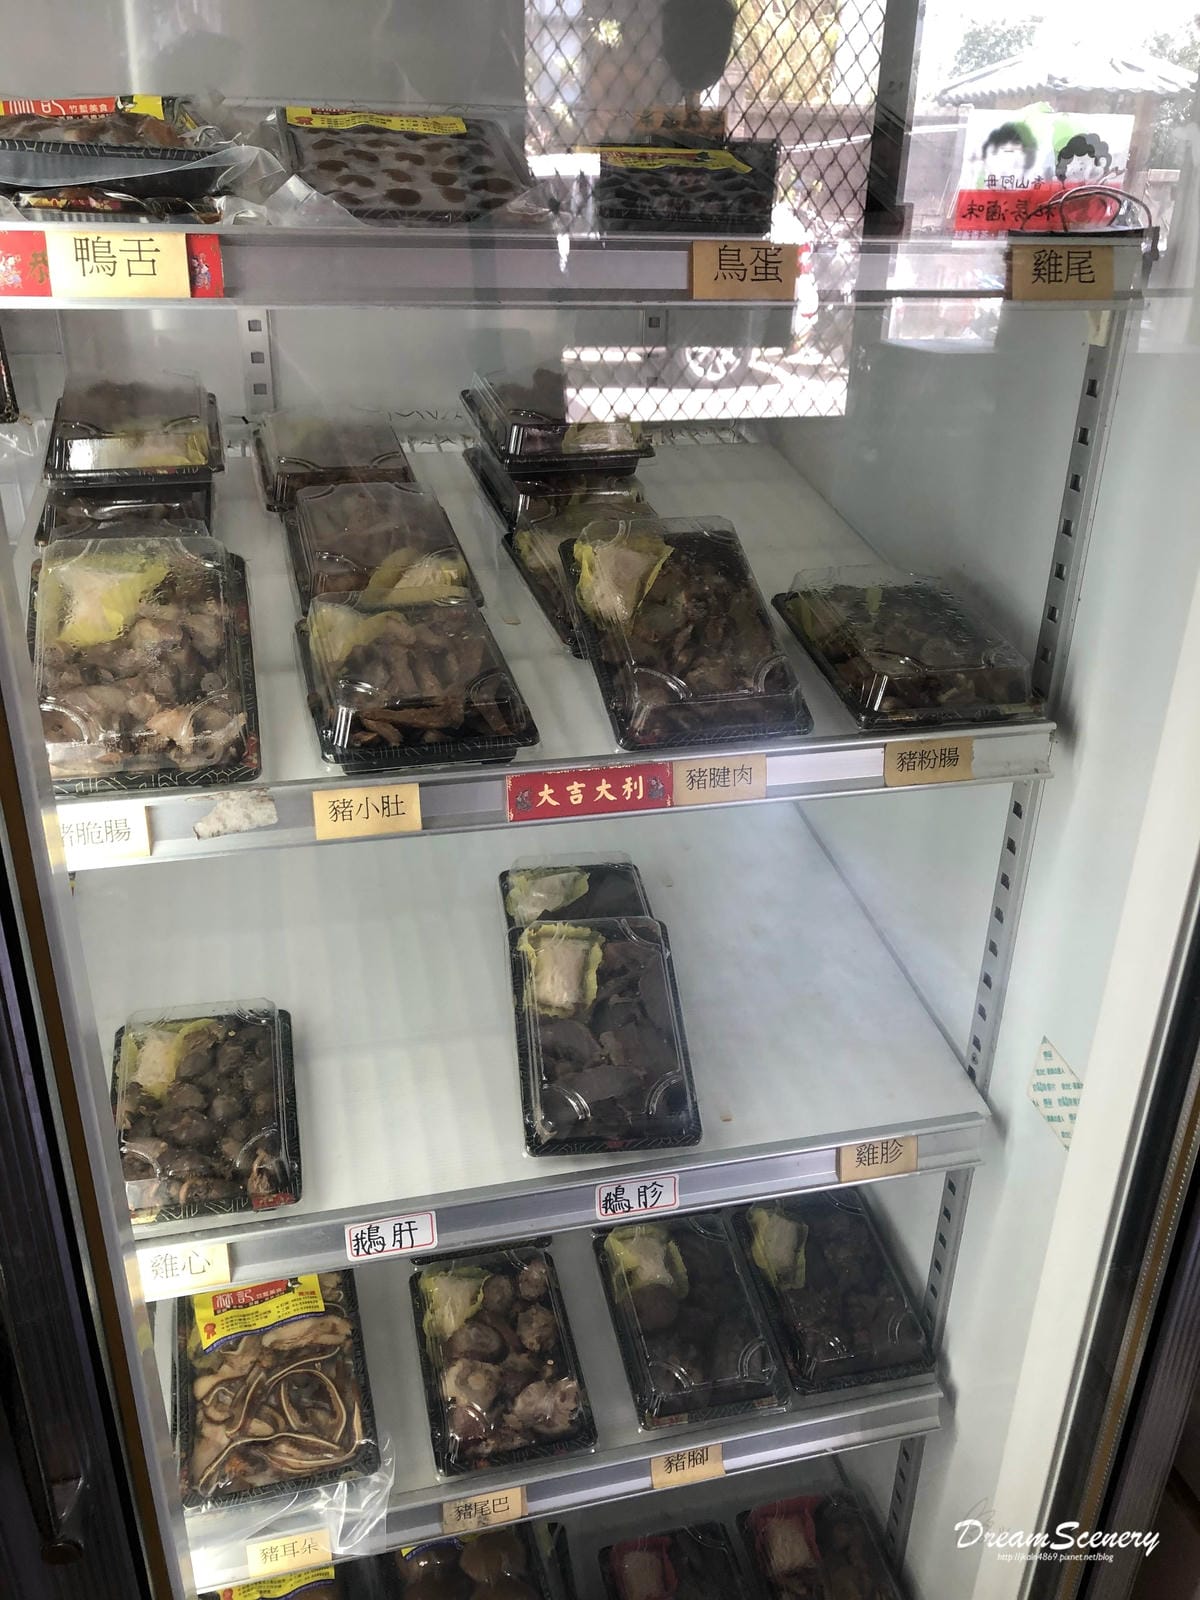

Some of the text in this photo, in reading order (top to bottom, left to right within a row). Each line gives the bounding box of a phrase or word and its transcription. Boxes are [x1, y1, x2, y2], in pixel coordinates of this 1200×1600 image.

[73, 236, 161, 278] 鴨舌
[713, 244, 783, 282] 鳥蛋
[1031, 249, 1096, 285] 雞尾
[896, 746, 961, 773] 豬粉腸
[535, 775, 645, 808] 大吉大利
[686, 764, 753, 791] 豬腱肉
[327, 793, 406, 823] 豬小肚
[855, 1138, 904, 1168] 雞胗
[602, 1181, 664, 1214] 鵝胗
[352, 1221, 418, 1257] 鵝肝
[150, 1249, 211, 1279] 雞心
[663, 1446, 710, 1475] 豬腳
[455, 1496, 510, 1521] 豬尾巴
